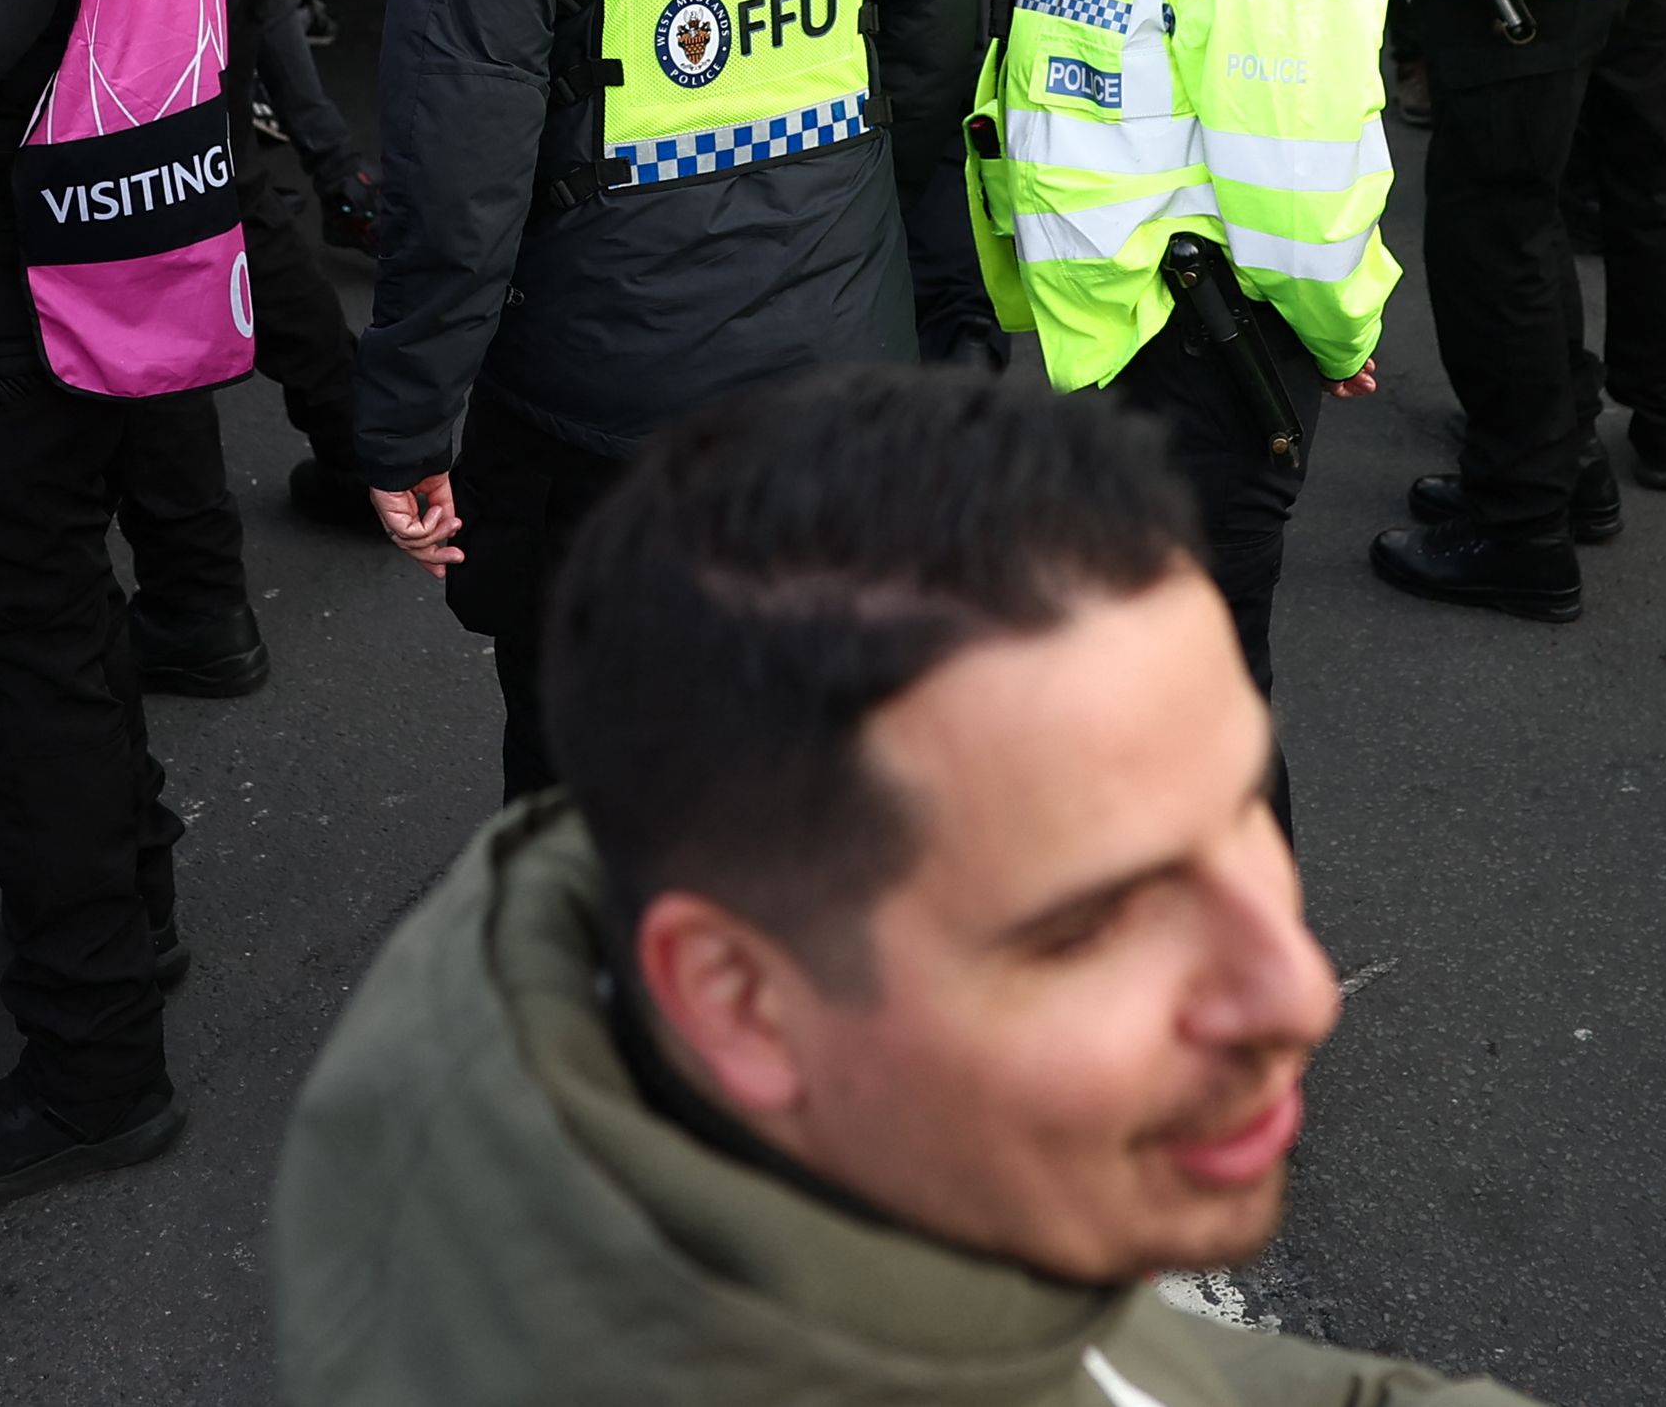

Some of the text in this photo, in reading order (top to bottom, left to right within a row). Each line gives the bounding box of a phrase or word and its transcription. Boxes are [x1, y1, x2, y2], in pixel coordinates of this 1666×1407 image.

[657, 9, 673, 47] WEST
[670, 62, 722, 86] POLICE
[1048, 62, 1121, 103] POLICE
[1226, 53, 1309, 84] POLICE
[41, 145, 228, 224] VISITING
